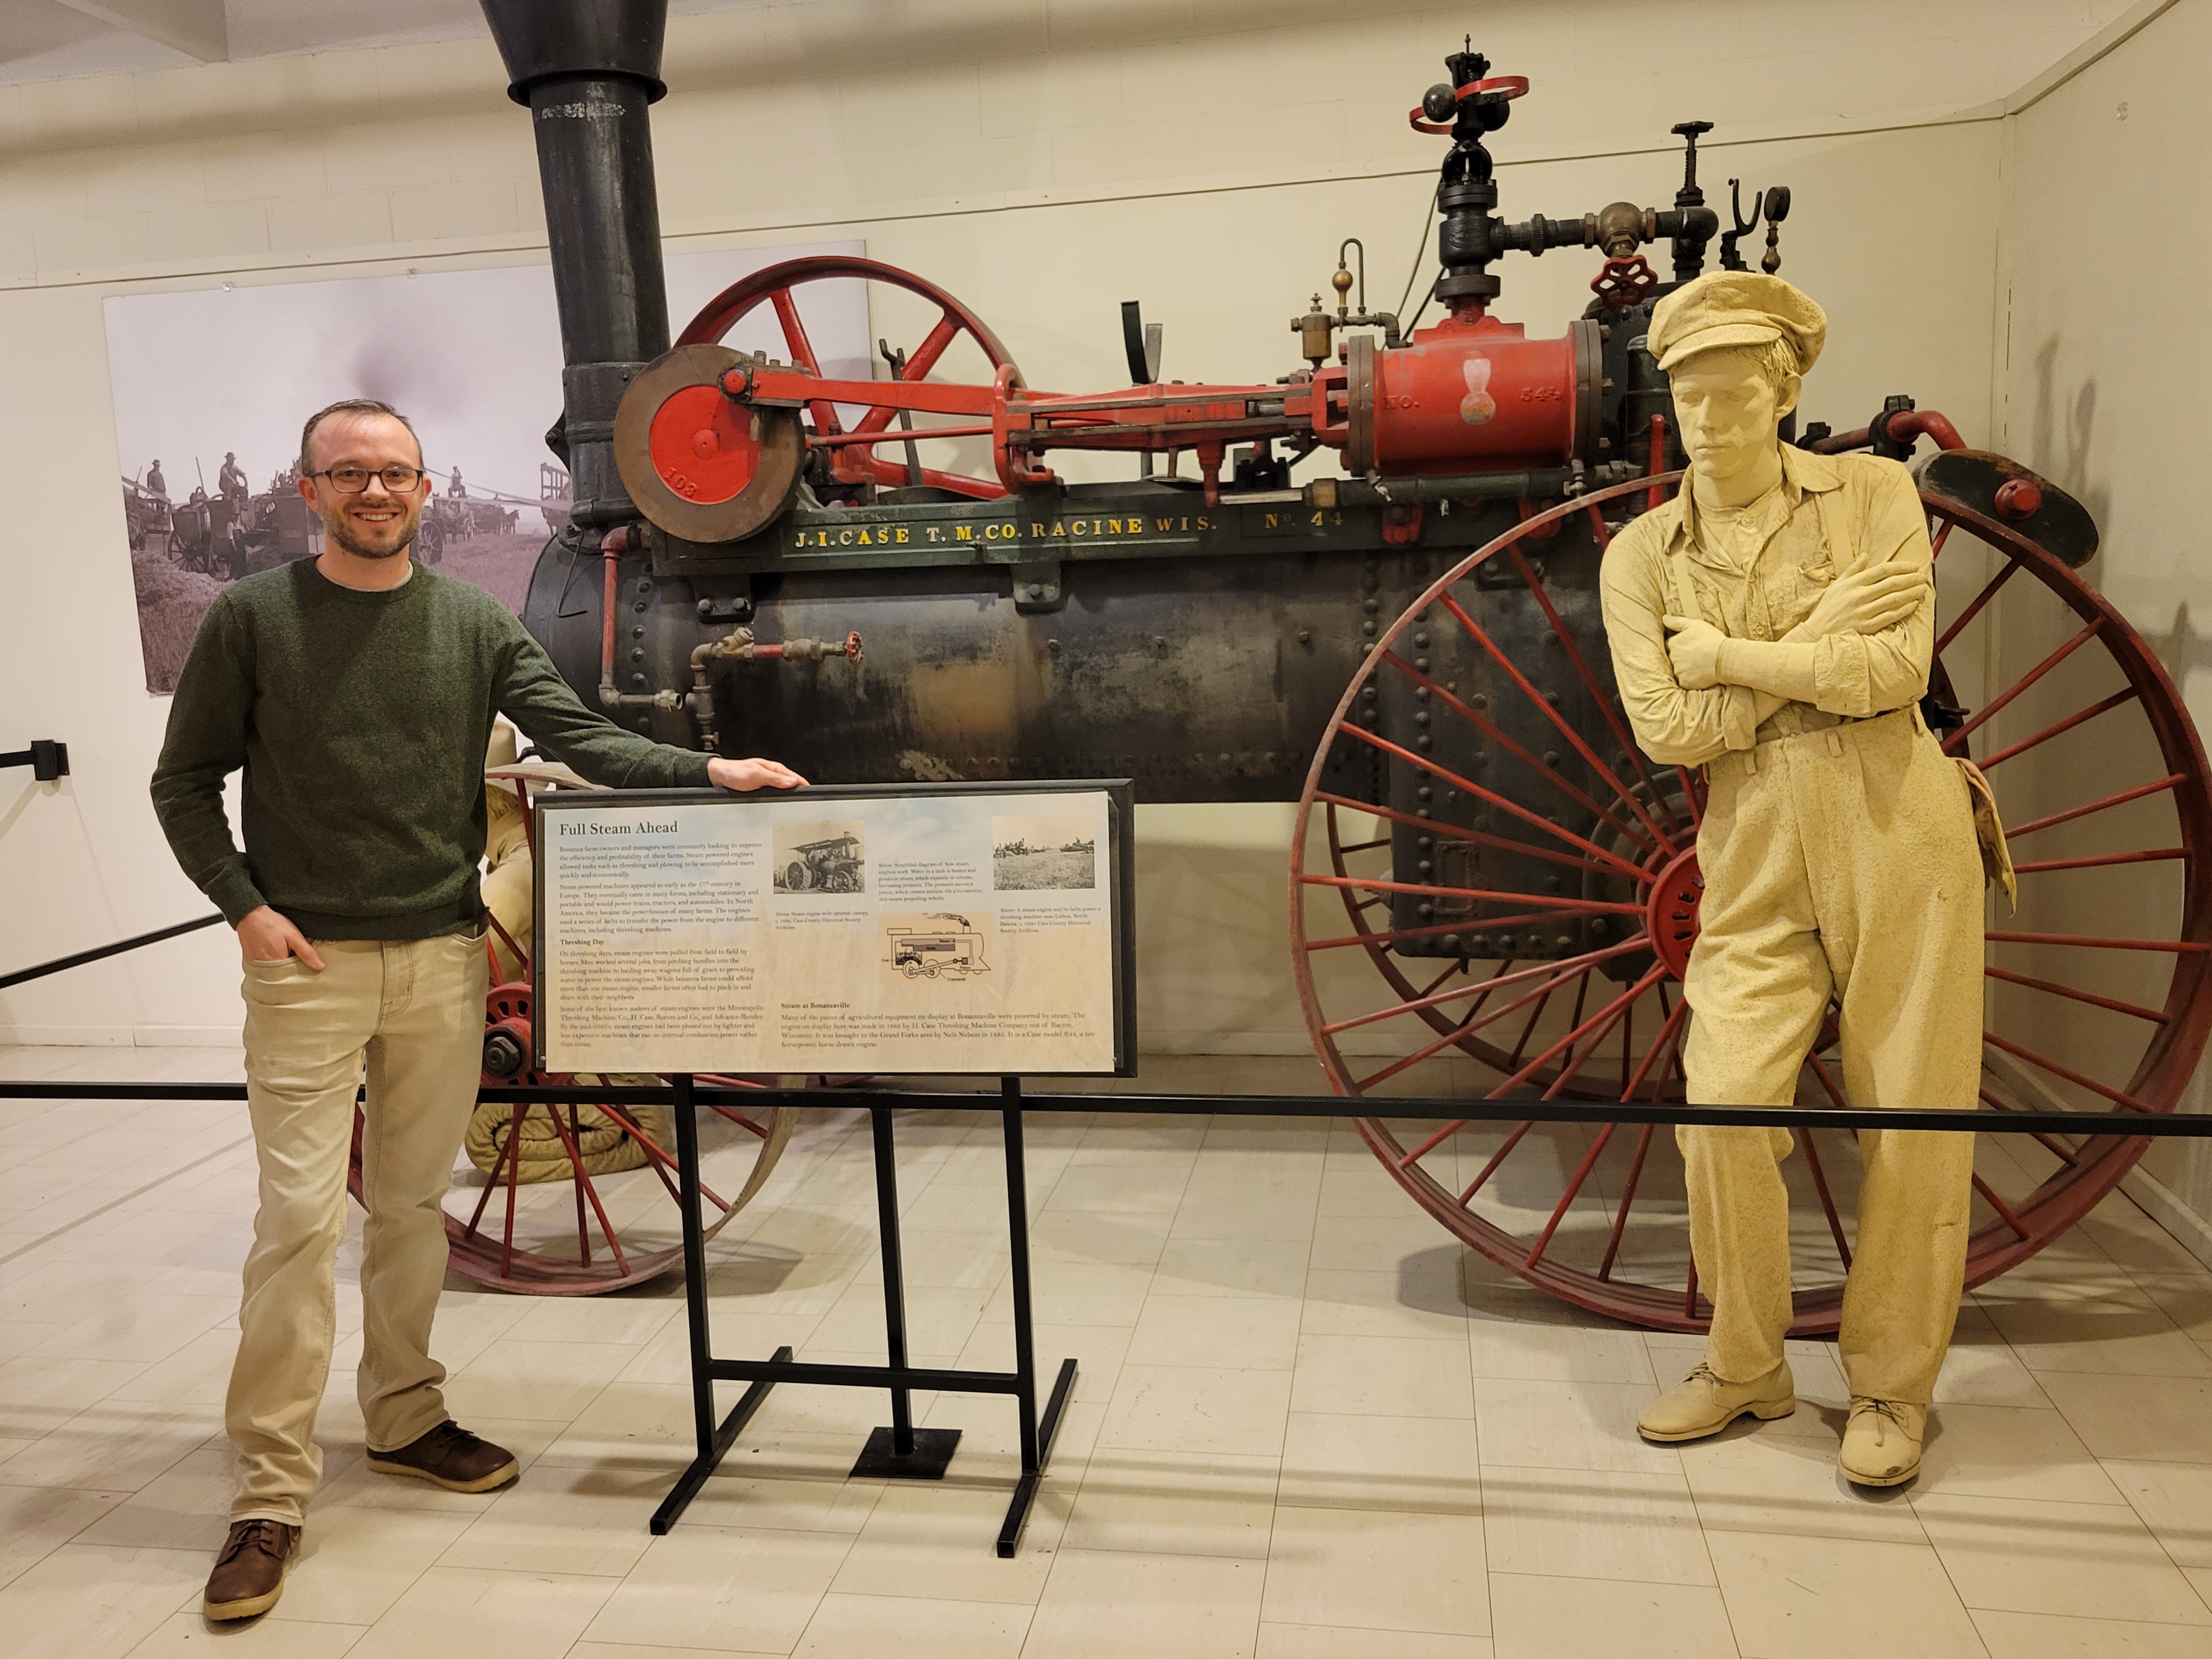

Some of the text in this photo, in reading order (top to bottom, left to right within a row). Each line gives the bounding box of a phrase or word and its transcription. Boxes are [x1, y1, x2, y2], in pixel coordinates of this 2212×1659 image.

[1031, 518, 1143, 538] RACINE
[1156, 516, 1218, 531] WIS.
[561, 821, 677, 836] Full Steam Ahead
[677, 843, 706, 851] constantly
[708, 842, 729, 851] looking
[570, 854, 595, 862] efficiency
[609, 853, 641, 862] profitability
[706, 851, 729, 859] powered
[620, 861, 646, 870] threshing
[659, 861, 682, 869] plowing
[700, 860, 738, 868] accomplished
[560, 872, 579, 880] quickly
[583, 891, 597, 900] They
[599, 891, 627, 900] eventually
[689, 889, 715, 898] including
[717, 889, 746, 898] stationary
[560, 900, 582, 909] portable
[588, 926, 614, 935] including
[617, 926, 643, 934] threshing
[561, 938, 603, 947] Threshing Day
[571, 950, 597, 958] threshing
[670, 949, 687, 957] pulled
[741, 948, 747, 956] by
[781, 1014, 798, 1022] Many
[927, 1013, 947, 1022] display
[1014, 1013, 1040, 1021] powered
[812, 1023, 831, 1031] display
[902, 1022, 909, 1030] by
[938, 1022, 969, 1030] Threshing
[999, 1022, 1027, 1030] Company
